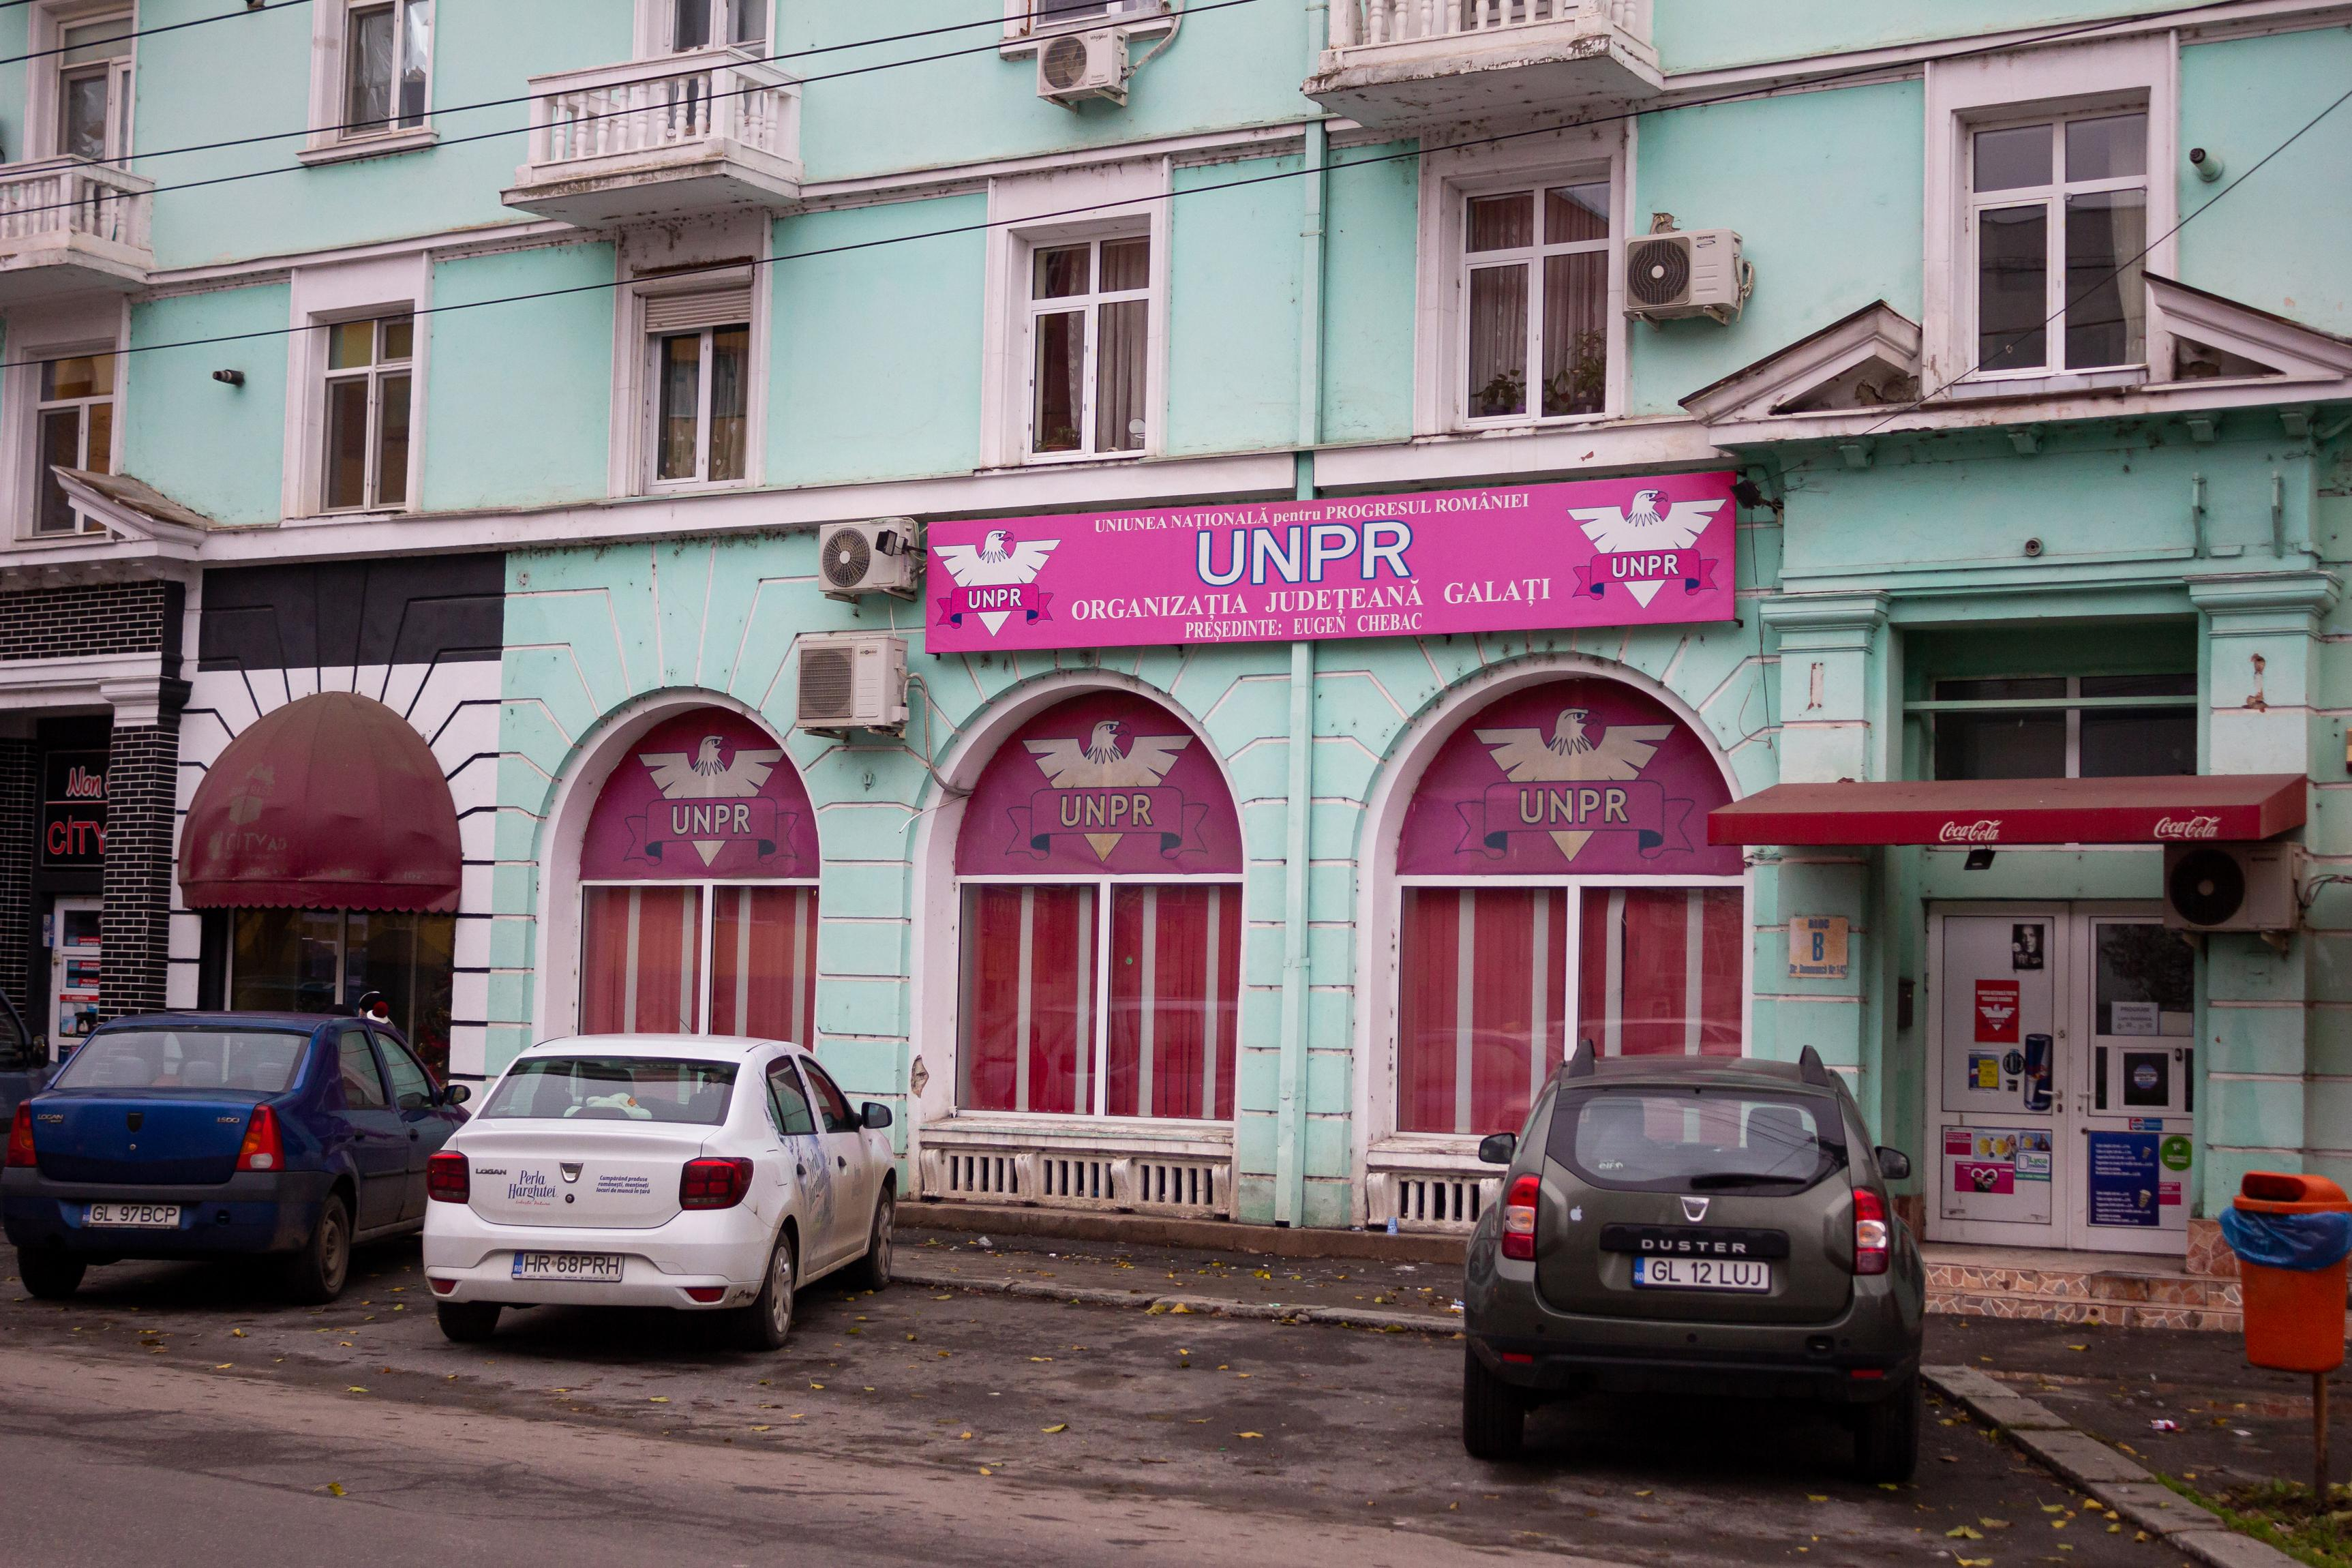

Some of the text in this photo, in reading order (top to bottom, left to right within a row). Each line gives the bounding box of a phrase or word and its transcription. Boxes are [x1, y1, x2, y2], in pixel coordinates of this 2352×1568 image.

[1095, 492, 1530, 533] UNIUNEA NAȚIONALĂ pentru PROGRESUL ROMÂNIEI
[1196, 519, 1413, 587] UNPR
[1612, 554, 1680, 578] UNPR
[967, 588, 1023, 609] UNPR
[1071, 577, 1552, 622] ORGANIZAȚIA JUDEȚEANĂ GALAȚI
[1293, 616, 1346, 636] EUGEN
[1357, 612, 1423, 633] CHEBAC
[66, 766, 102, 798] Non
[671, 802, 751, 835] UNPR
[1060, 794, 1154, 828] UNPR
[1519, 788, 1629, 825] UNPR
[48, 816, 108, 855] CITY
[1938, 819, 2003, 842] Coca-Cola
[2154, 815, 2221, 839] Coca-Cola
[1812, 932, 1824, 961] B
[519, 1170, 546, 1186] Perla
[508, 1183, 557, 1201] Harghitei
[92, 1205, 177, 1223] GL 97BCP
[1641, 1239, 1747, 1253] DUSTER
[524, 1255, 620, 1275] HR 68PRH
[1634, 1271, 1644, 1281] RO
[1652, 1261, 1762, 1286] GL 12 LUJ
